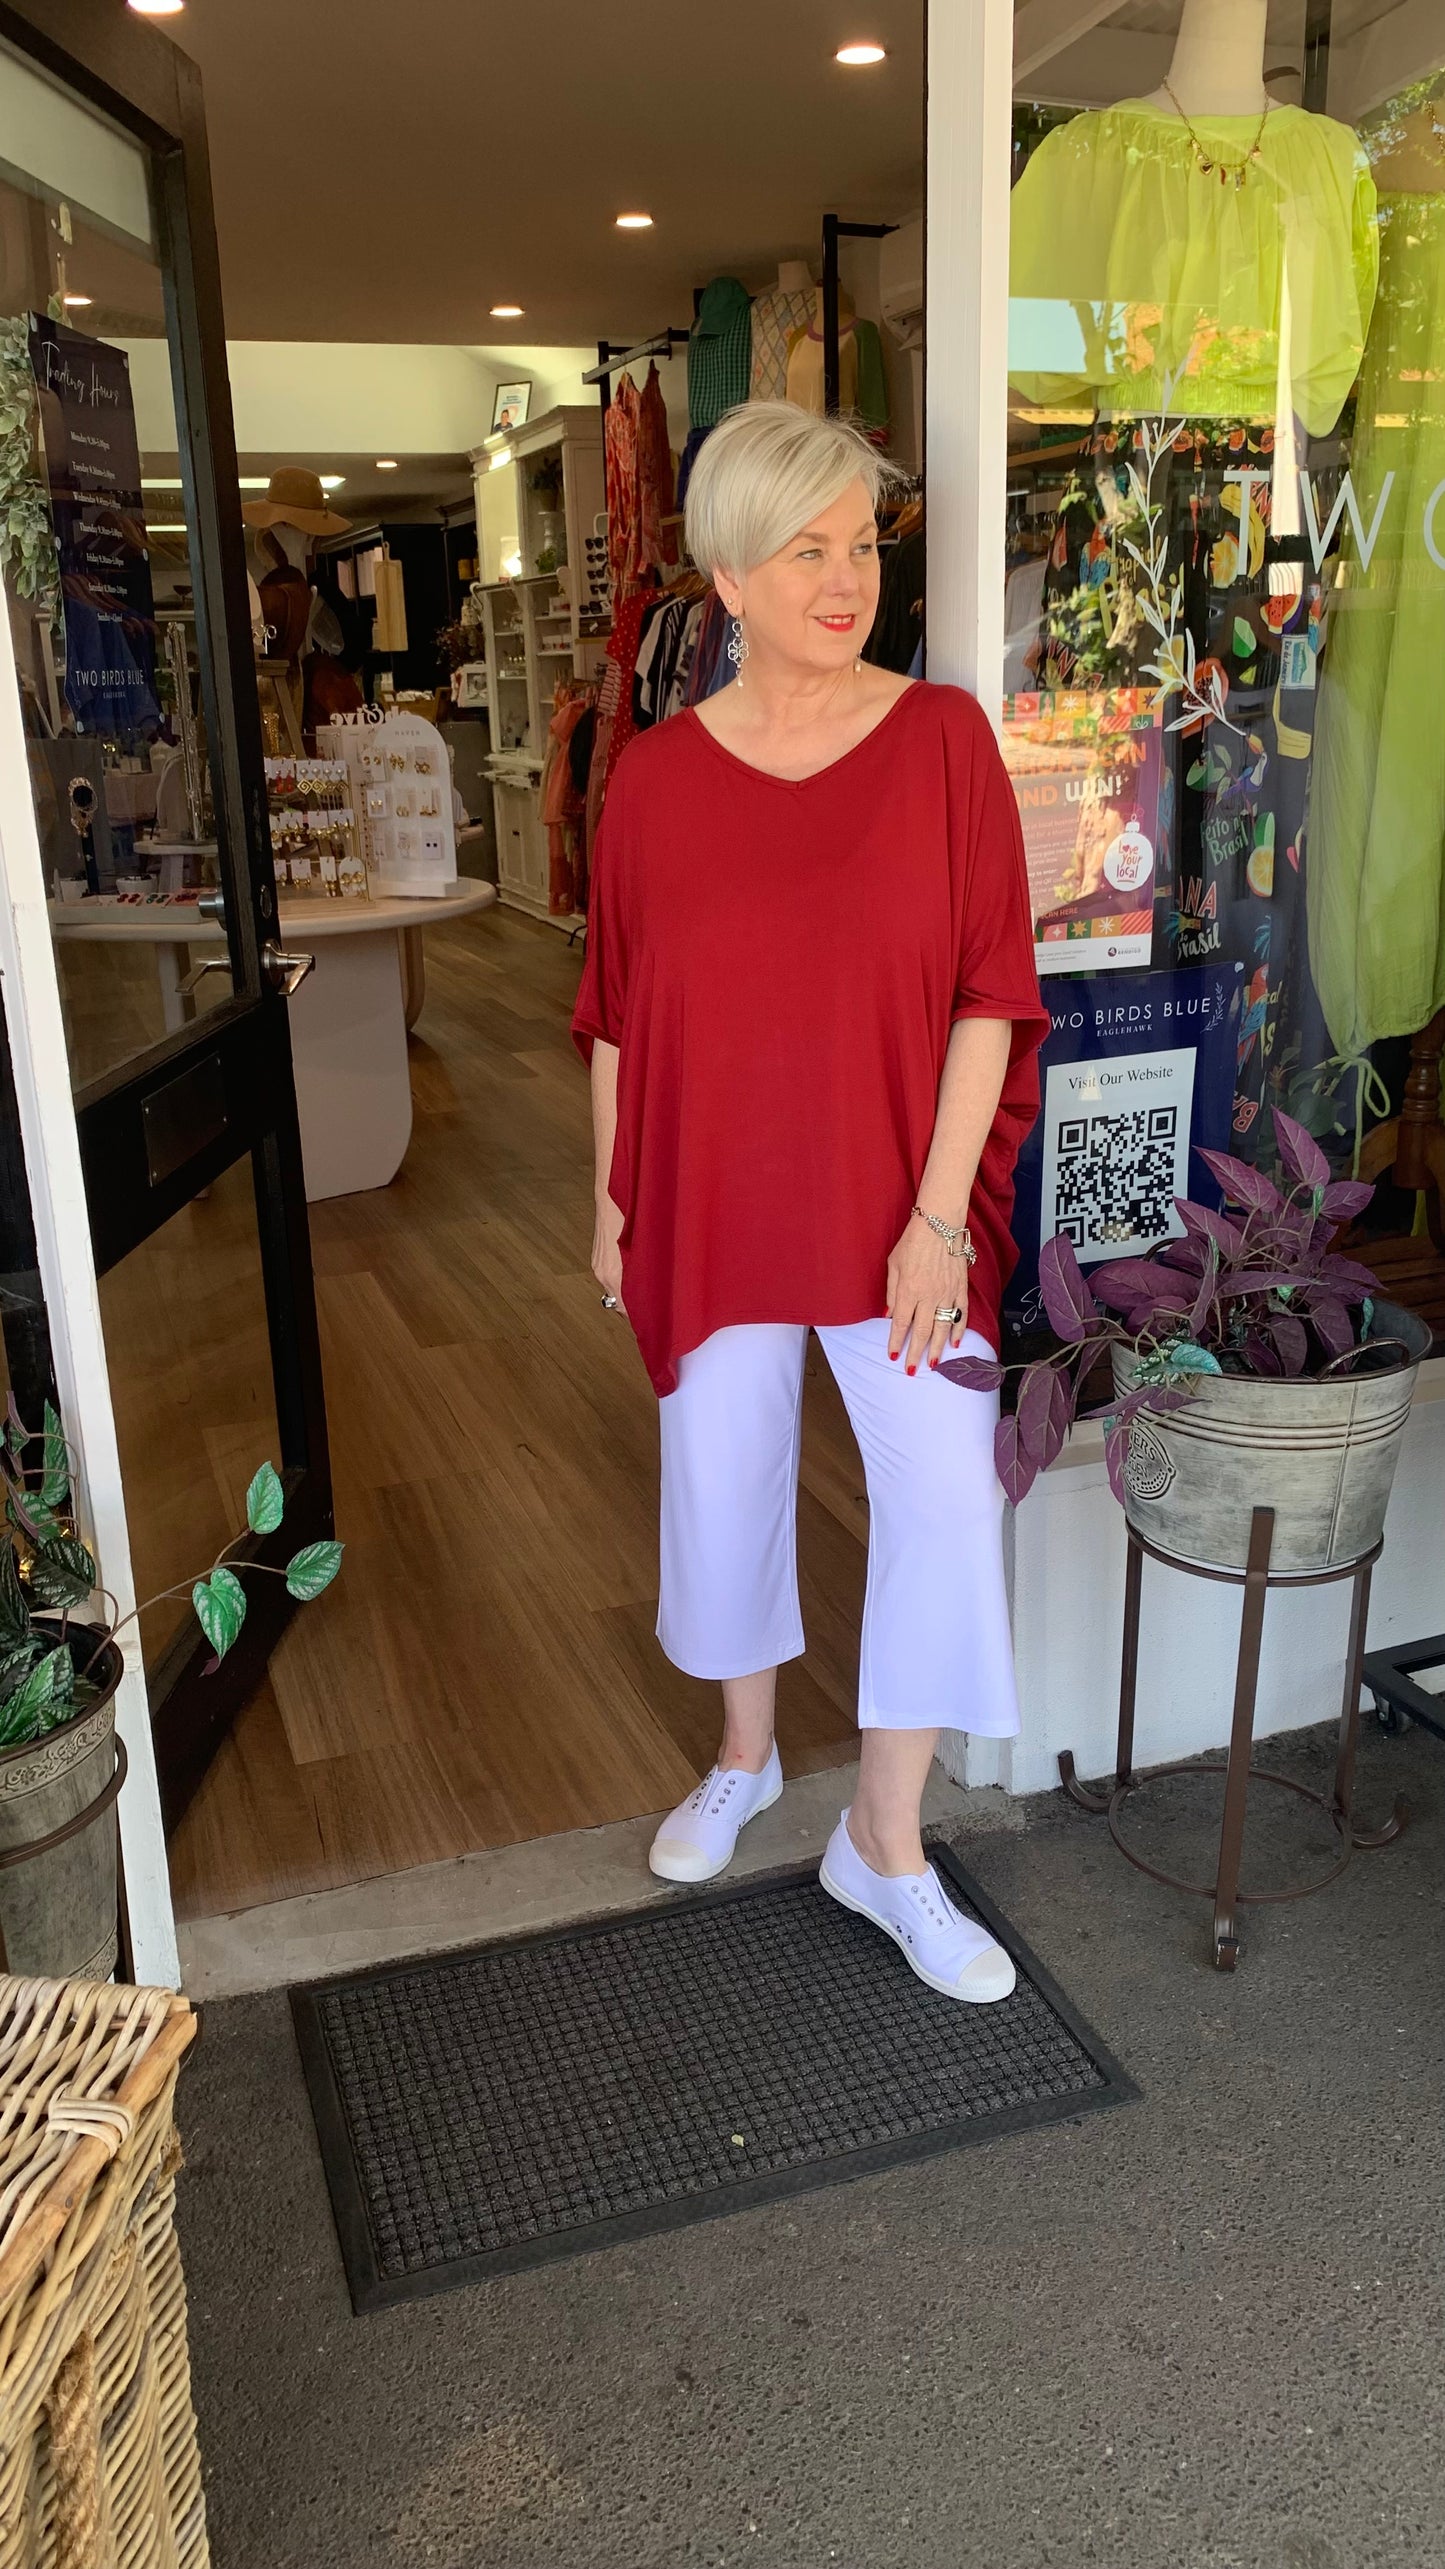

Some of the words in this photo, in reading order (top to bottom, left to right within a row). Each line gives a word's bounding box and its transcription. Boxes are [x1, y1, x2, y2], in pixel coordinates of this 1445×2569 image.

[1223, 470, 1445, 574] TW
[75, 670, 98, 687] TWO
[101, 669, 125, 686] BIRDS
[127, 669, 145, 685] BLUE
[1015, 784, 1059, 809] ND
[1207, 821, 1249, 867] Brasil
[1116, 864, 1139, 879] local
[1178, 921, 1222, 959] rasil
[1051, 1012, 1084, 1031] WO
[1095, 1004, 1152, 1026] BIRDS
[1163, 997, 1211, 1018] BLUE
[1096, 1023, 1153, 1037] EAGLEHAWK
[1068, 1076, 1097, 1090] Visit
[1100, 1072, 1123, 1086] Our
[1127, 1065, 1174, 1082] Website
